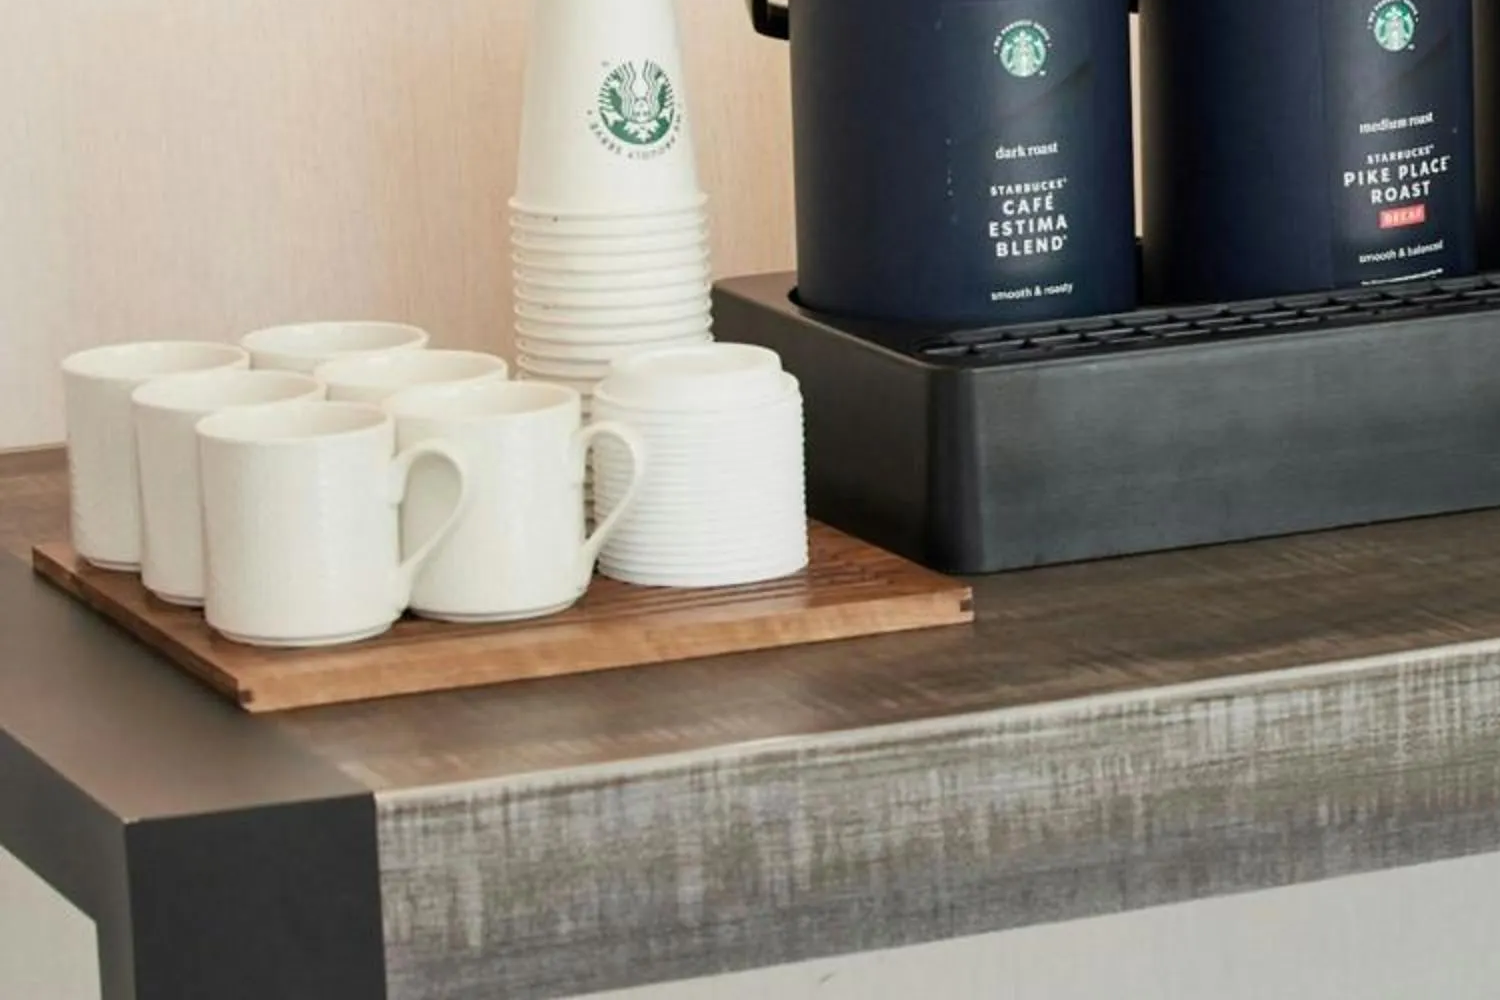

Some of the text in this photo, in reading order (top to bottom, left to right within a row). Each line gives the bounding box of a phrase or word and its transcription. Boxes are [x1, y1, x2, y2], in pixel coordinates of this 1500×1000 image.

[995, 141, 1059, 160] dark roast
[1343, 155, 1450, 187] PIKE PLACE
[1002, 191, 1054, 216] CAFÉ
[1371, 180, 1431, 204] ROAST
[989, 214, 1068, 238] ESTIMA
[1034, 285, 1042, 297] &
